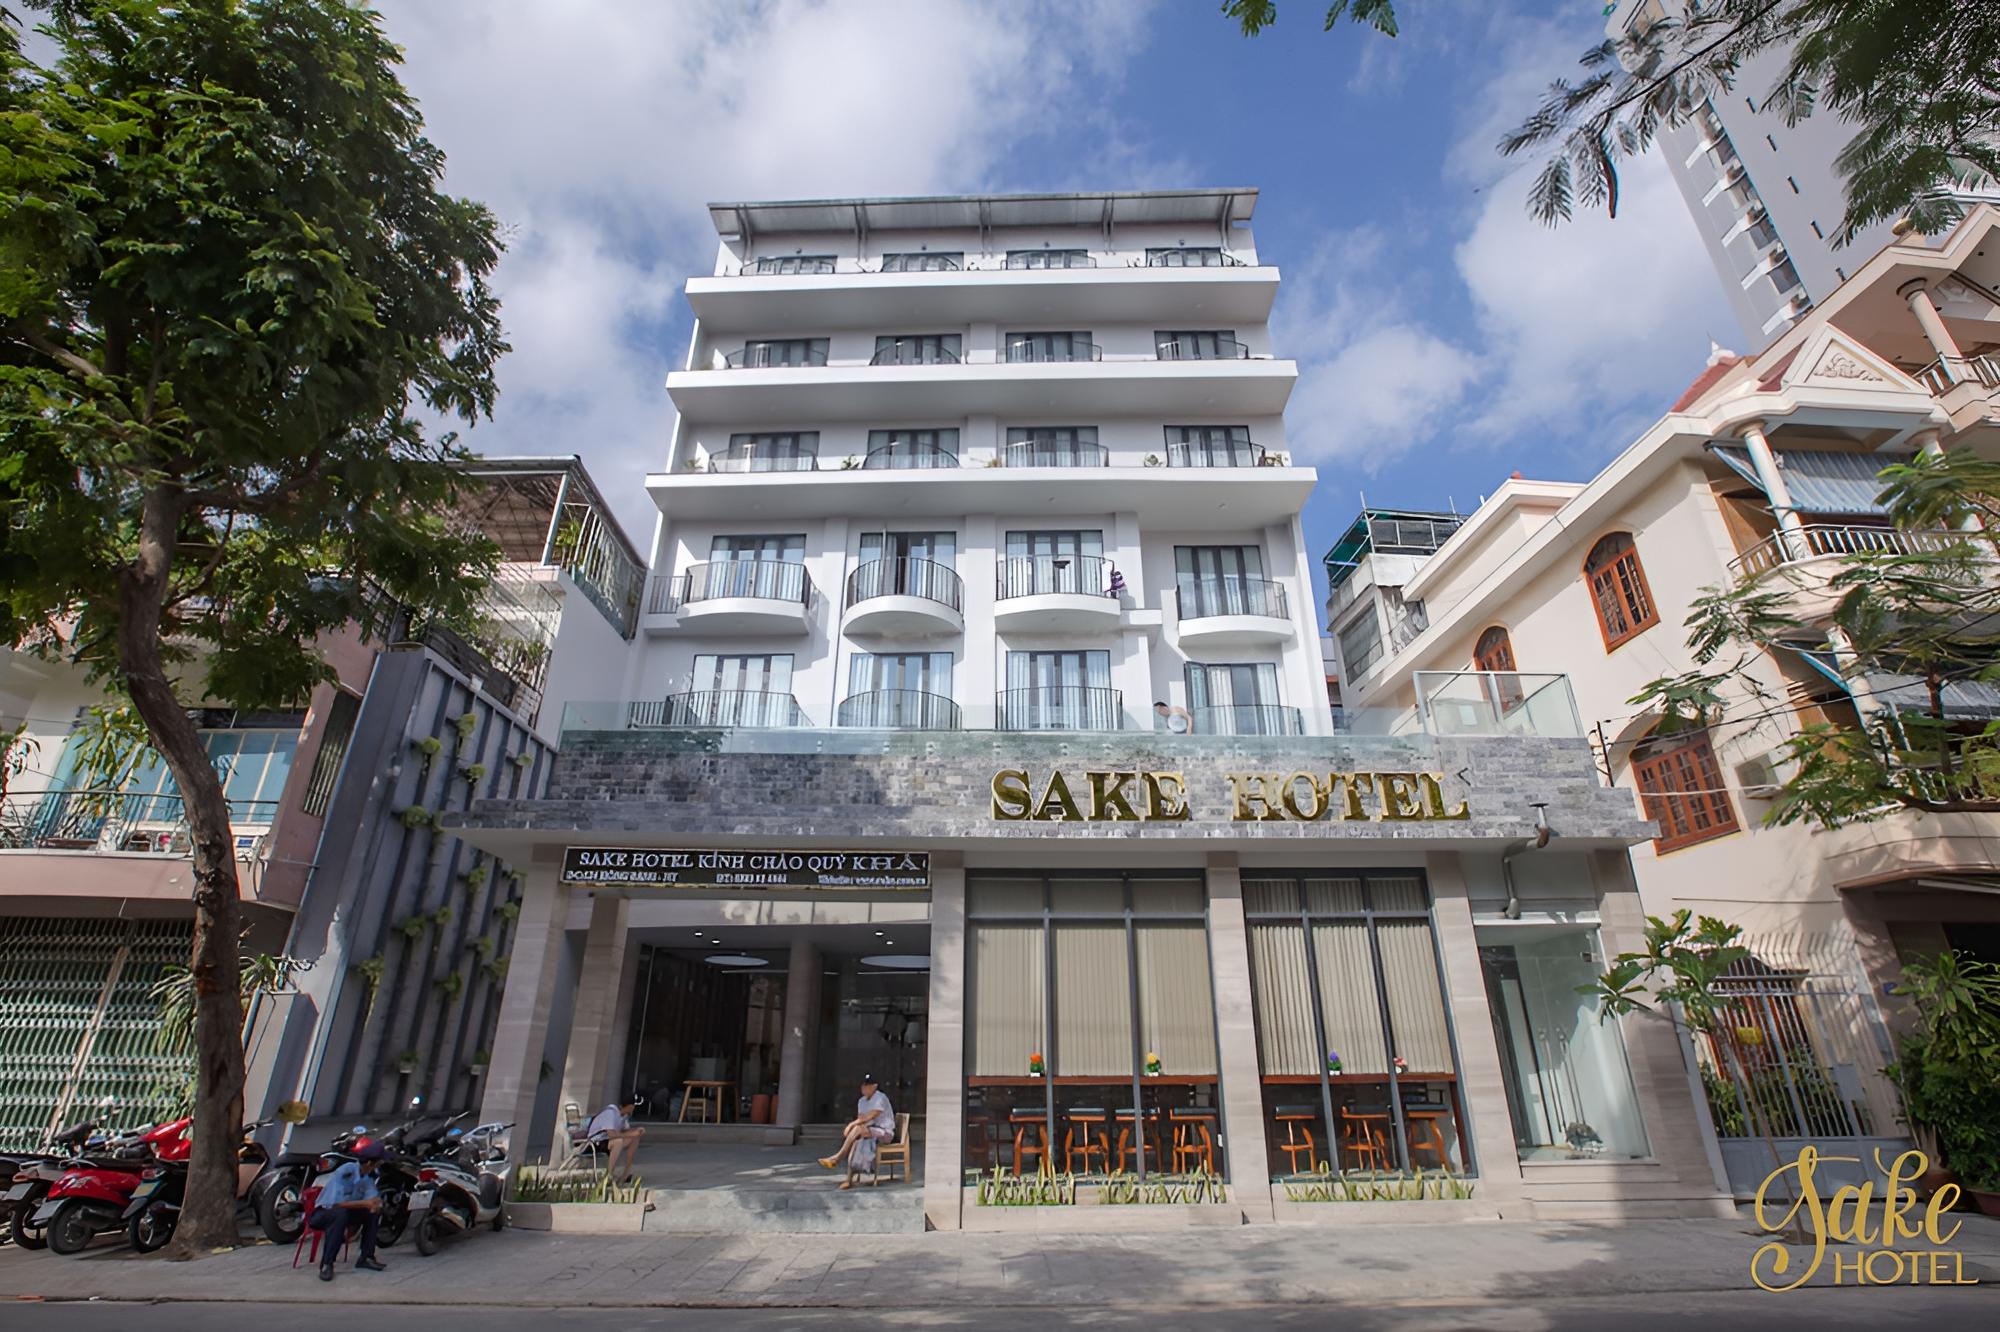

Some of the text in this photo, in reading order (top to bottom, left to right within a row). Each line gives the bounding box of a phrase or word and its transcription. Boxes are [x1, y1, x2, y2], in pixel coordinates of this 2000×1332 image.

[991, 768, 1471, 821] SAKE HOTEL
[579, 851, 628, 867] SAKE
[631, 853, 694, 868] HOTEL
